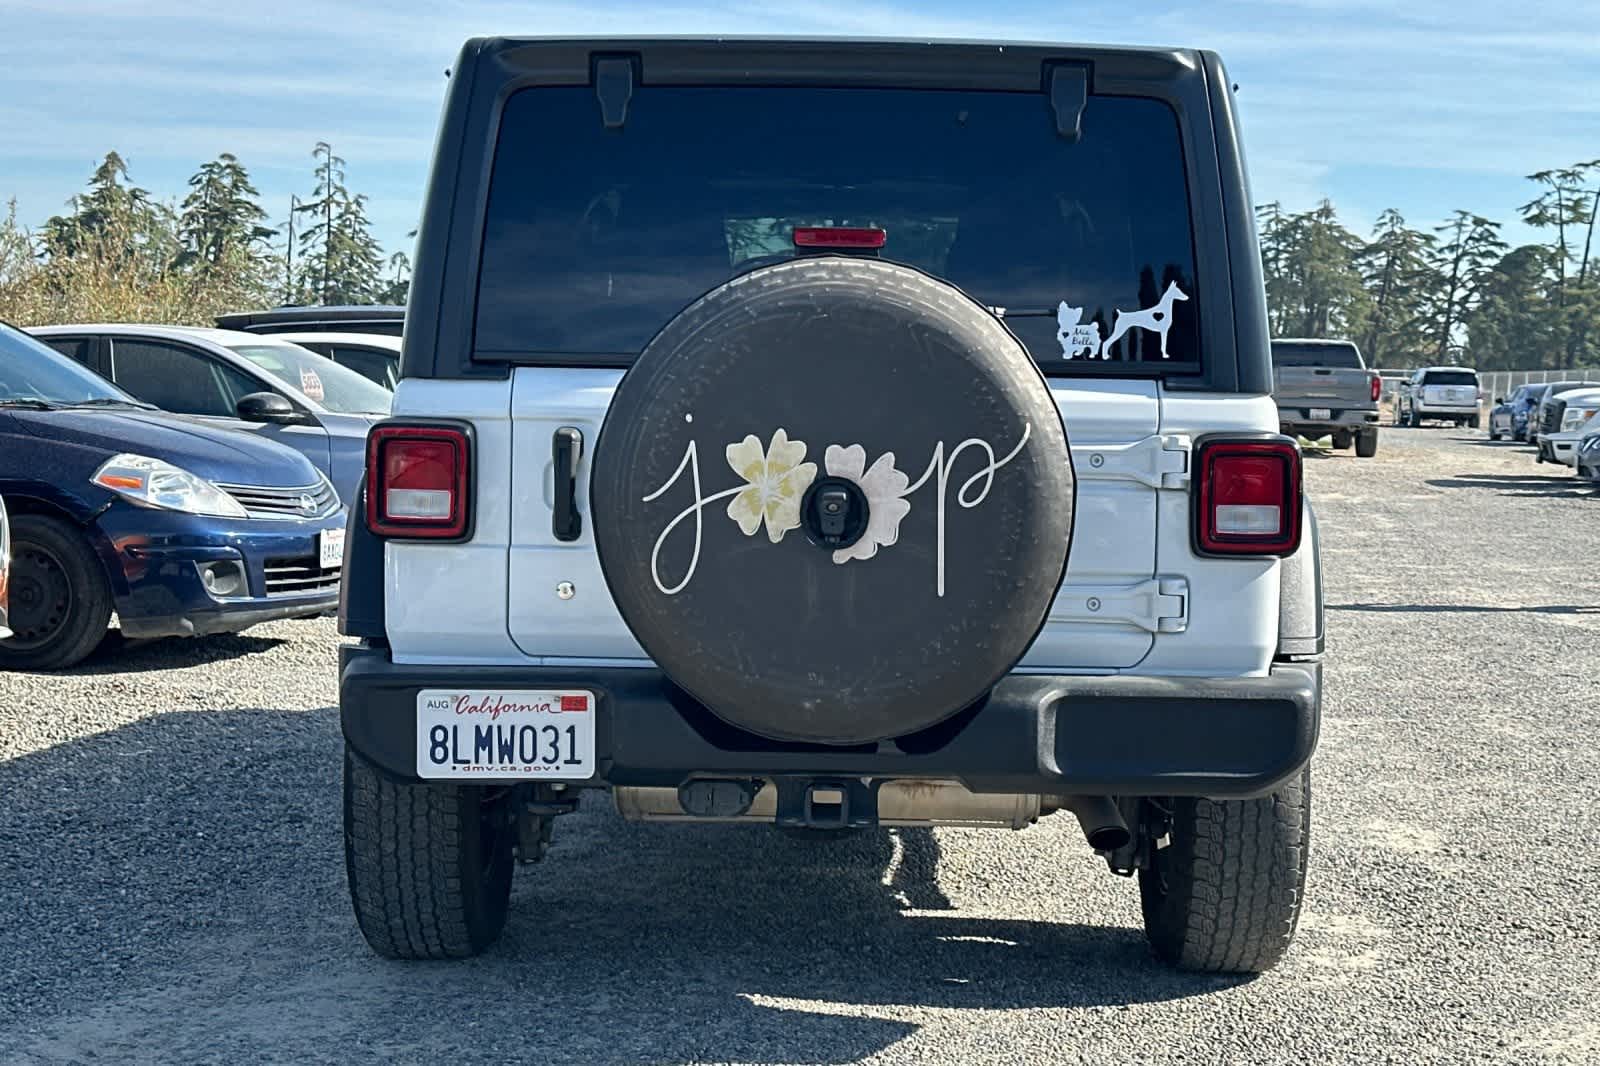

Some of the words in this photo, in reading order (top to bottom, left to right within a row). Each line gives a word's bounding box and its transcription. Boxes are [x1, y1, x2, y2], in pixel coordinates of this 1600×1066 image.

[1071, 336, 1095, 346] Bella
[427, 700, 449, 709] AUG
[455, 694, 562, 720] California
[429, 724, 583, 765] 8LMW031
